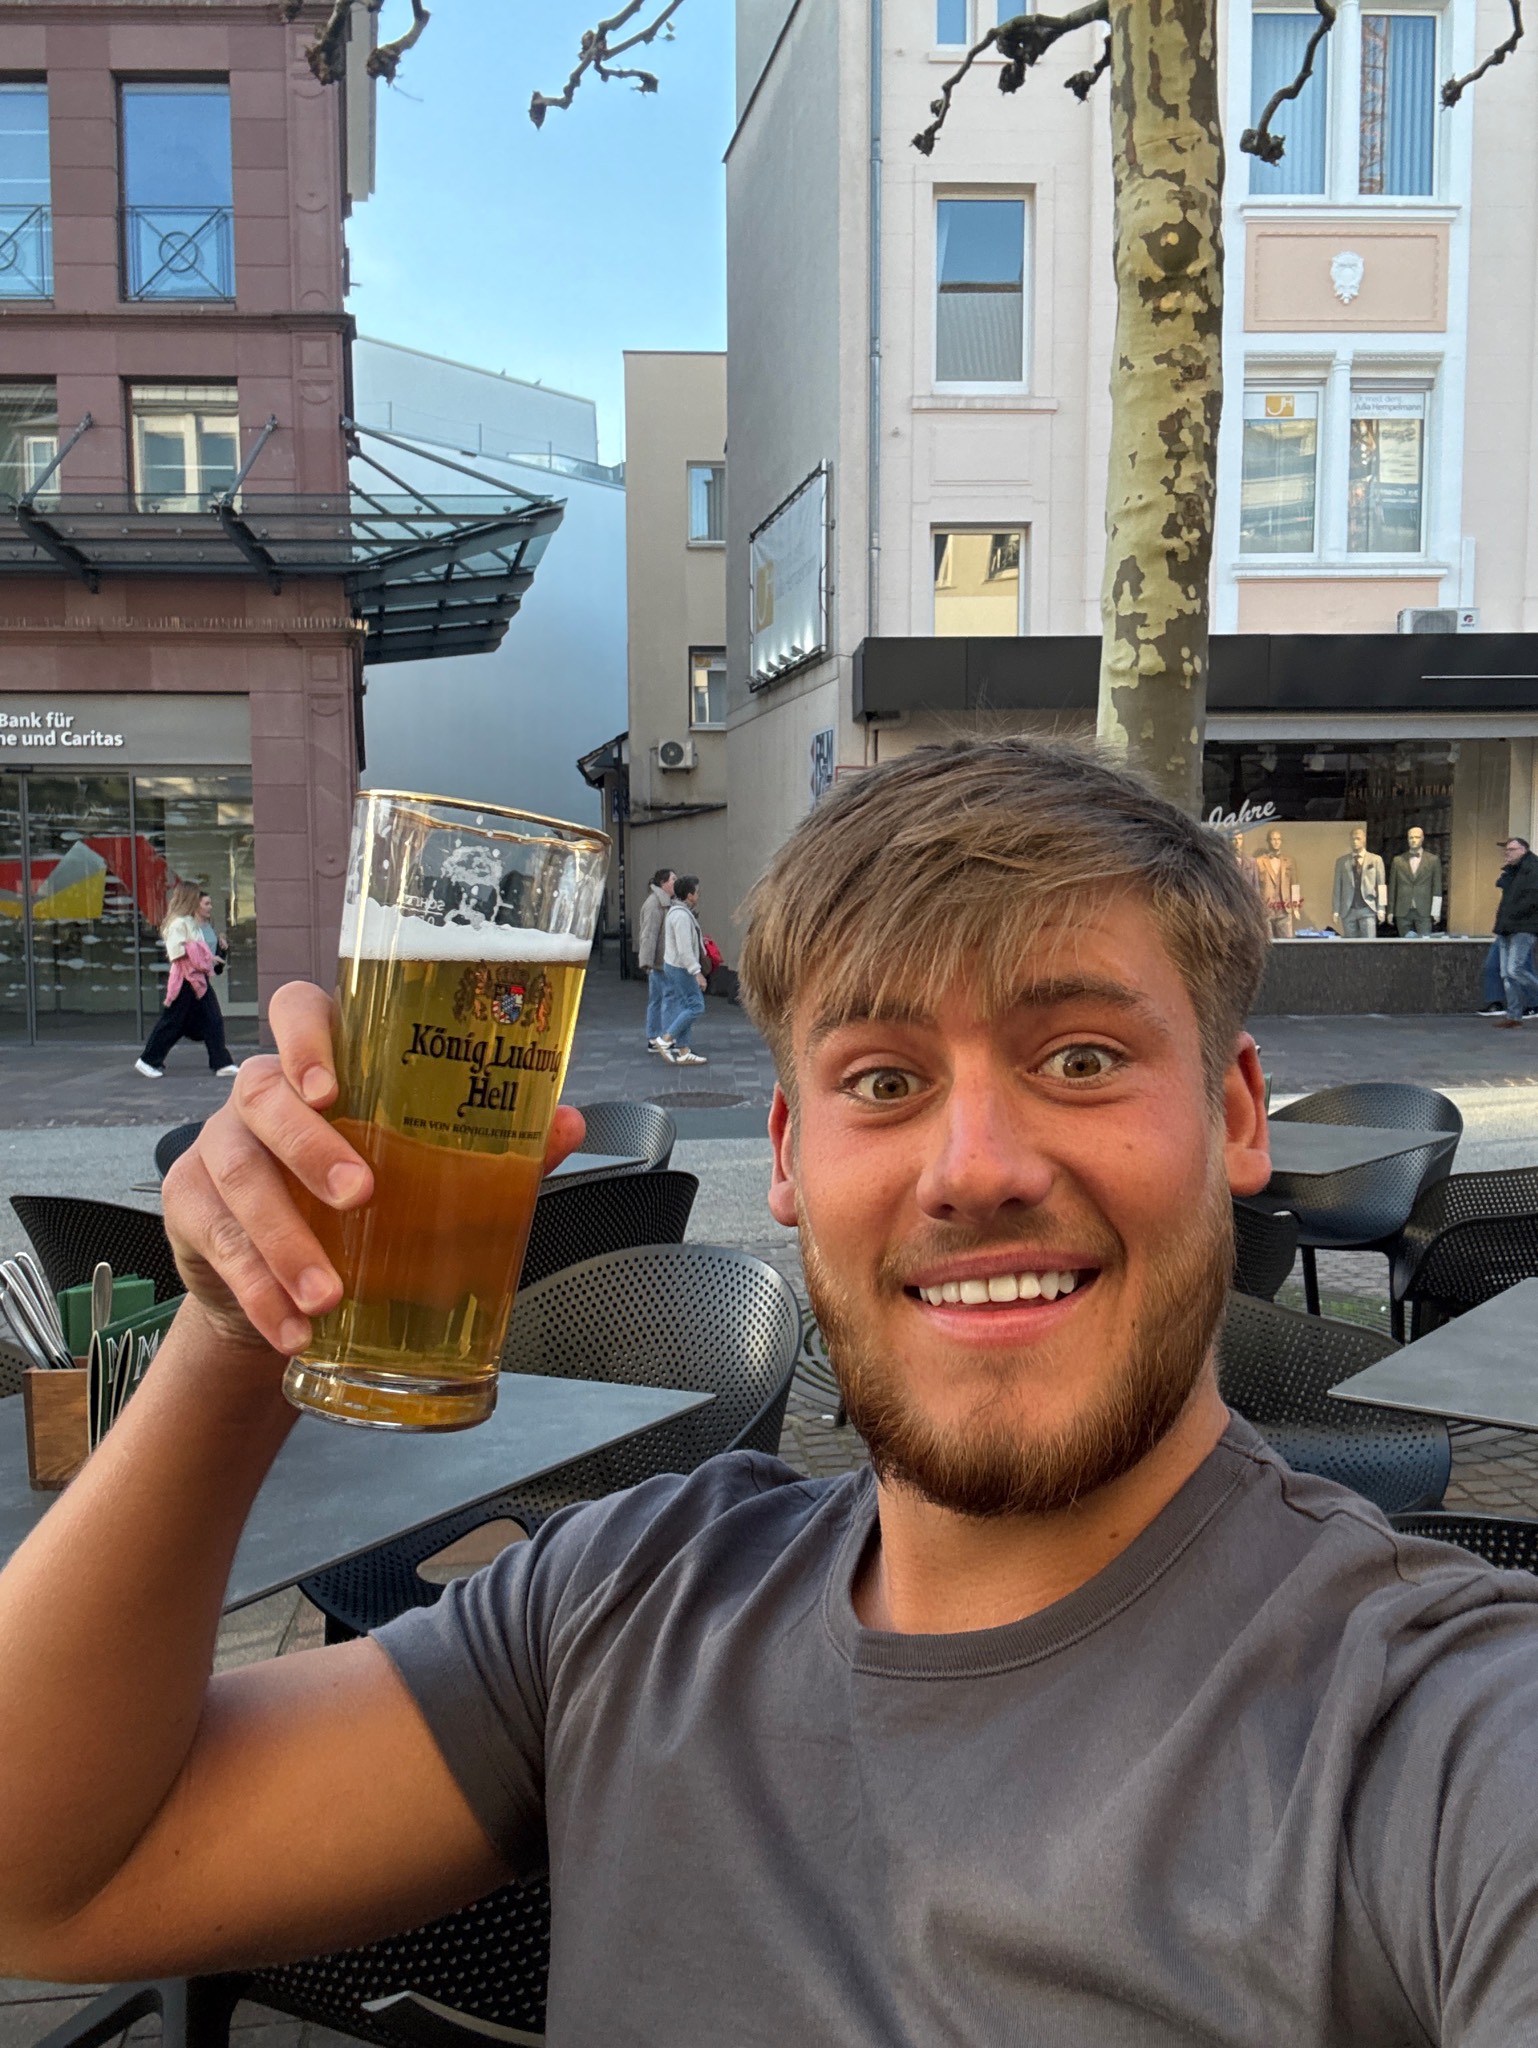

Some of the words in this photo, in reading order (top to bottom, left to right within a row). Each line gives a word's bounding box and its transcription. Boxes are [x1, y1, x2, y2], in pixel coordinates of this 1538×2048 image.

[0, 712, 42, 728] Bank
[45, 712, 74, 728] für
[22, 730, 56, 746] und
[60, 730, 124, 747] Caritas
[1208, 798, 1277, 831] Jahre
[401, 1023, 489, 1074] König
[483, 1035, 562, 1082] Ludwig
[457, 1075, 519, 1117] Hell
[403, 1116, 427, 1129] BIER
[429, 1120, 450, 1133] VON
[452, 1122, 517, 1139] KÖNIGLICHER
